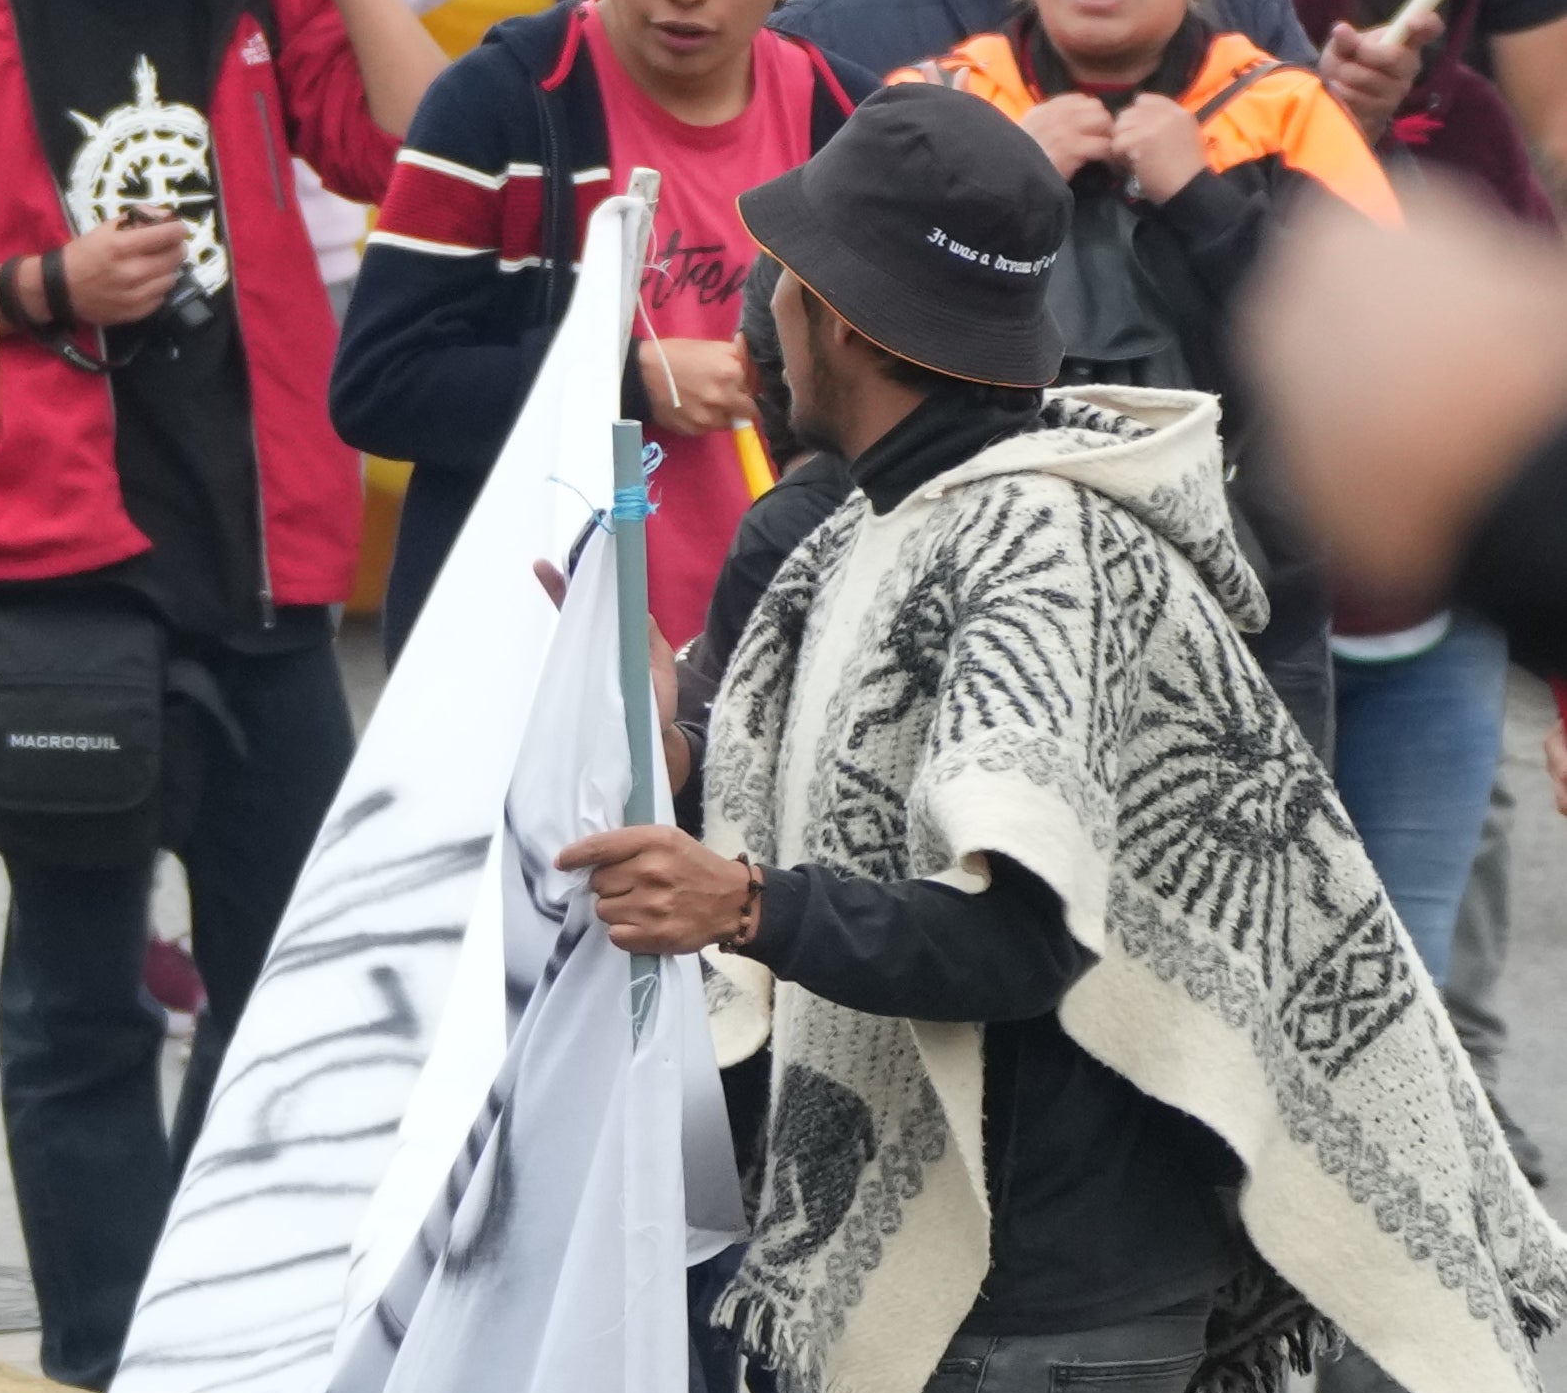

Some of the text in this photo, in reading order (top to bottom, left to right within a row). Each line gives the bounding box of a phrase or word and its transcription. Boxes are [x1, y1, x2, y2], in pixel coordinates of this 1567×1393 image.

[949, 240, 979, 262] was
[979, 253, 991, 266] a
[9, 733, 121, 751] MACROQUIL
